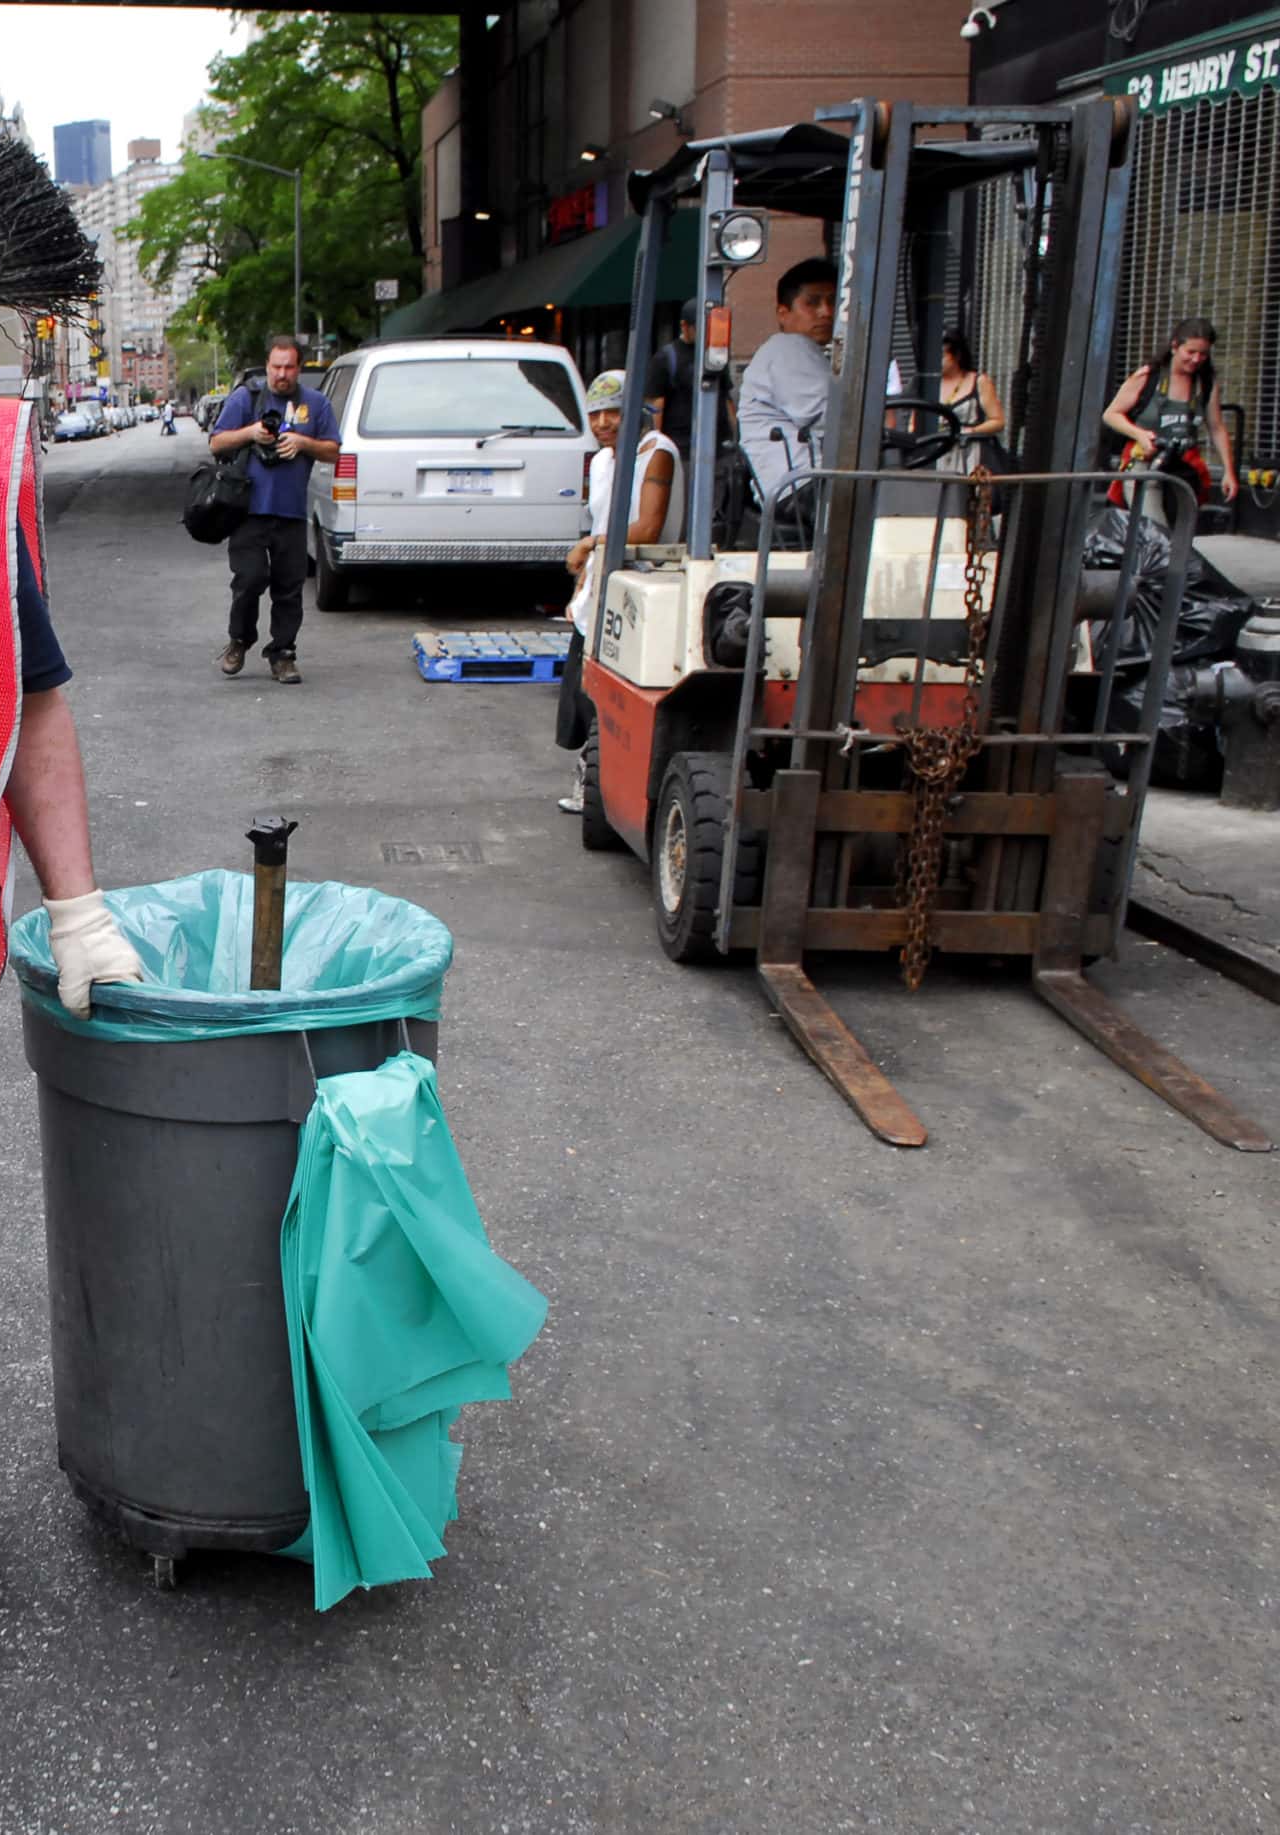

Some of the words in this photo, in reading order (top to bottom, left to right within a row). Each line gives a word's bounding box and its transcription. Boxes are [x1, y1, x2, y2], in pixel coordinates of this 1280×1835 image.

[1159, 50, 1235, 104] HENRY
[1244, 38, 1280, 83] ST.
[839, 134, 865, 323] NISSAN
[604, 608, 623, 641] 30
